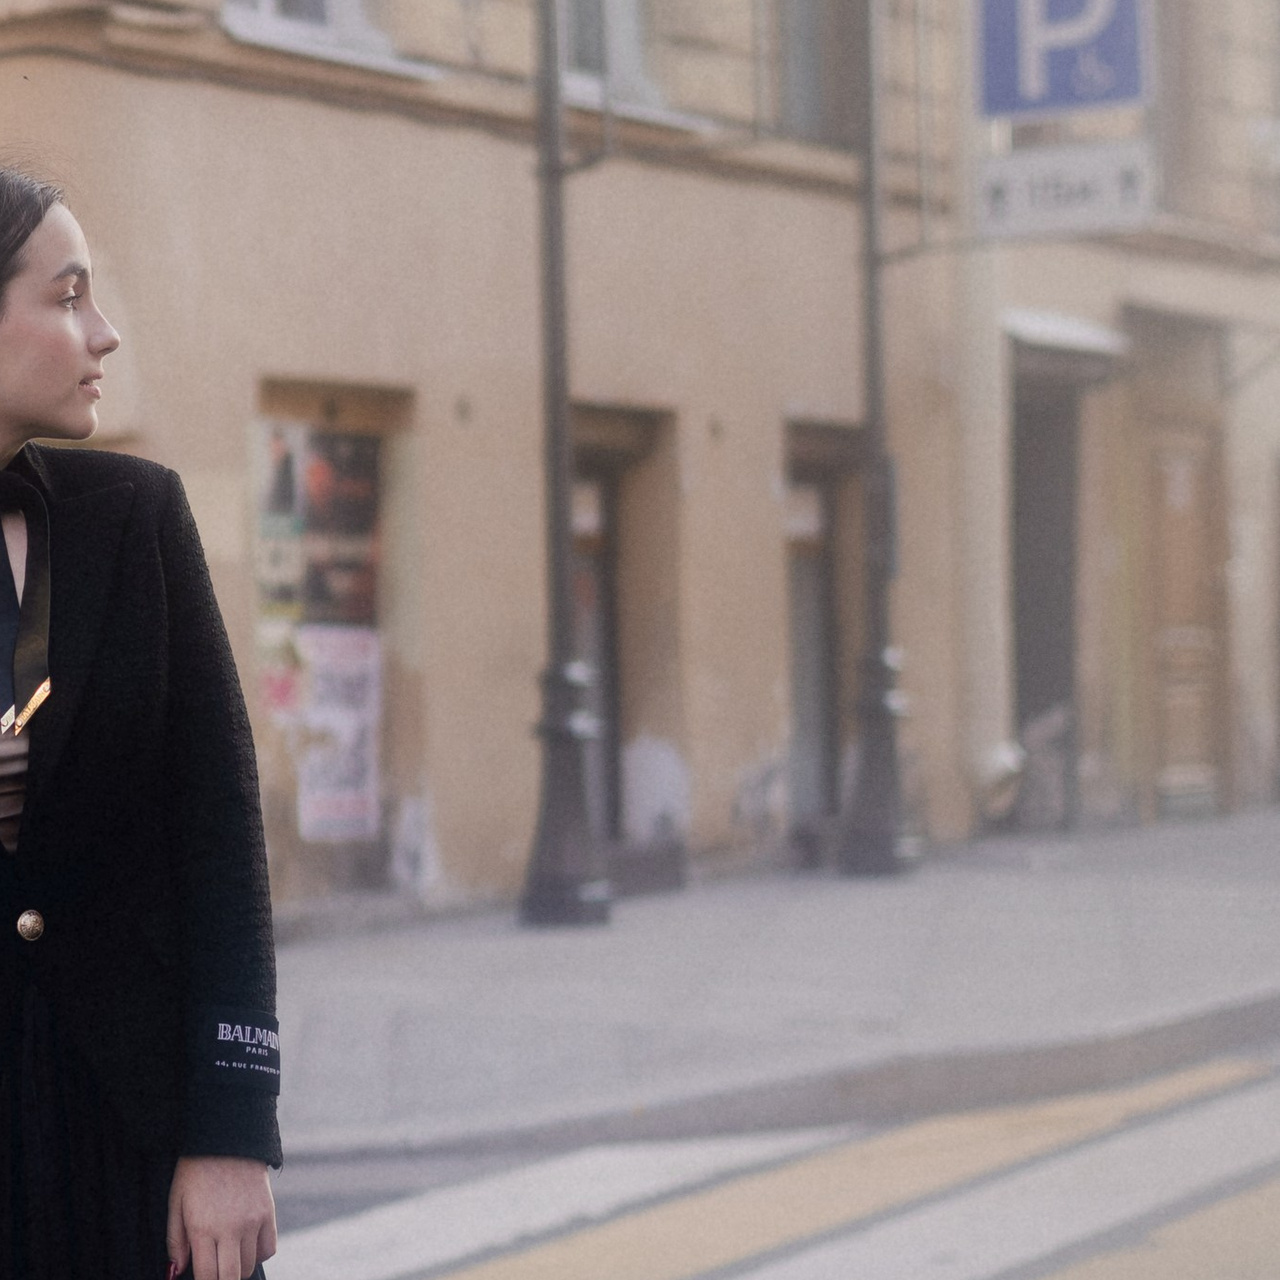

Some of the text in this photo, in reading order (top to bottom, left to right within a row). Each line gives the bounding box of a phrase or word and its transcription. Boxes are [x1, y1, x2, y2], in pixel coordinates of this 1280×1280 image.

[217, 1023, 279, 1051] BALMAIN
[246, 1046, 268, 1056] PARIS
[232, 1061, 247, 1070] RUE
